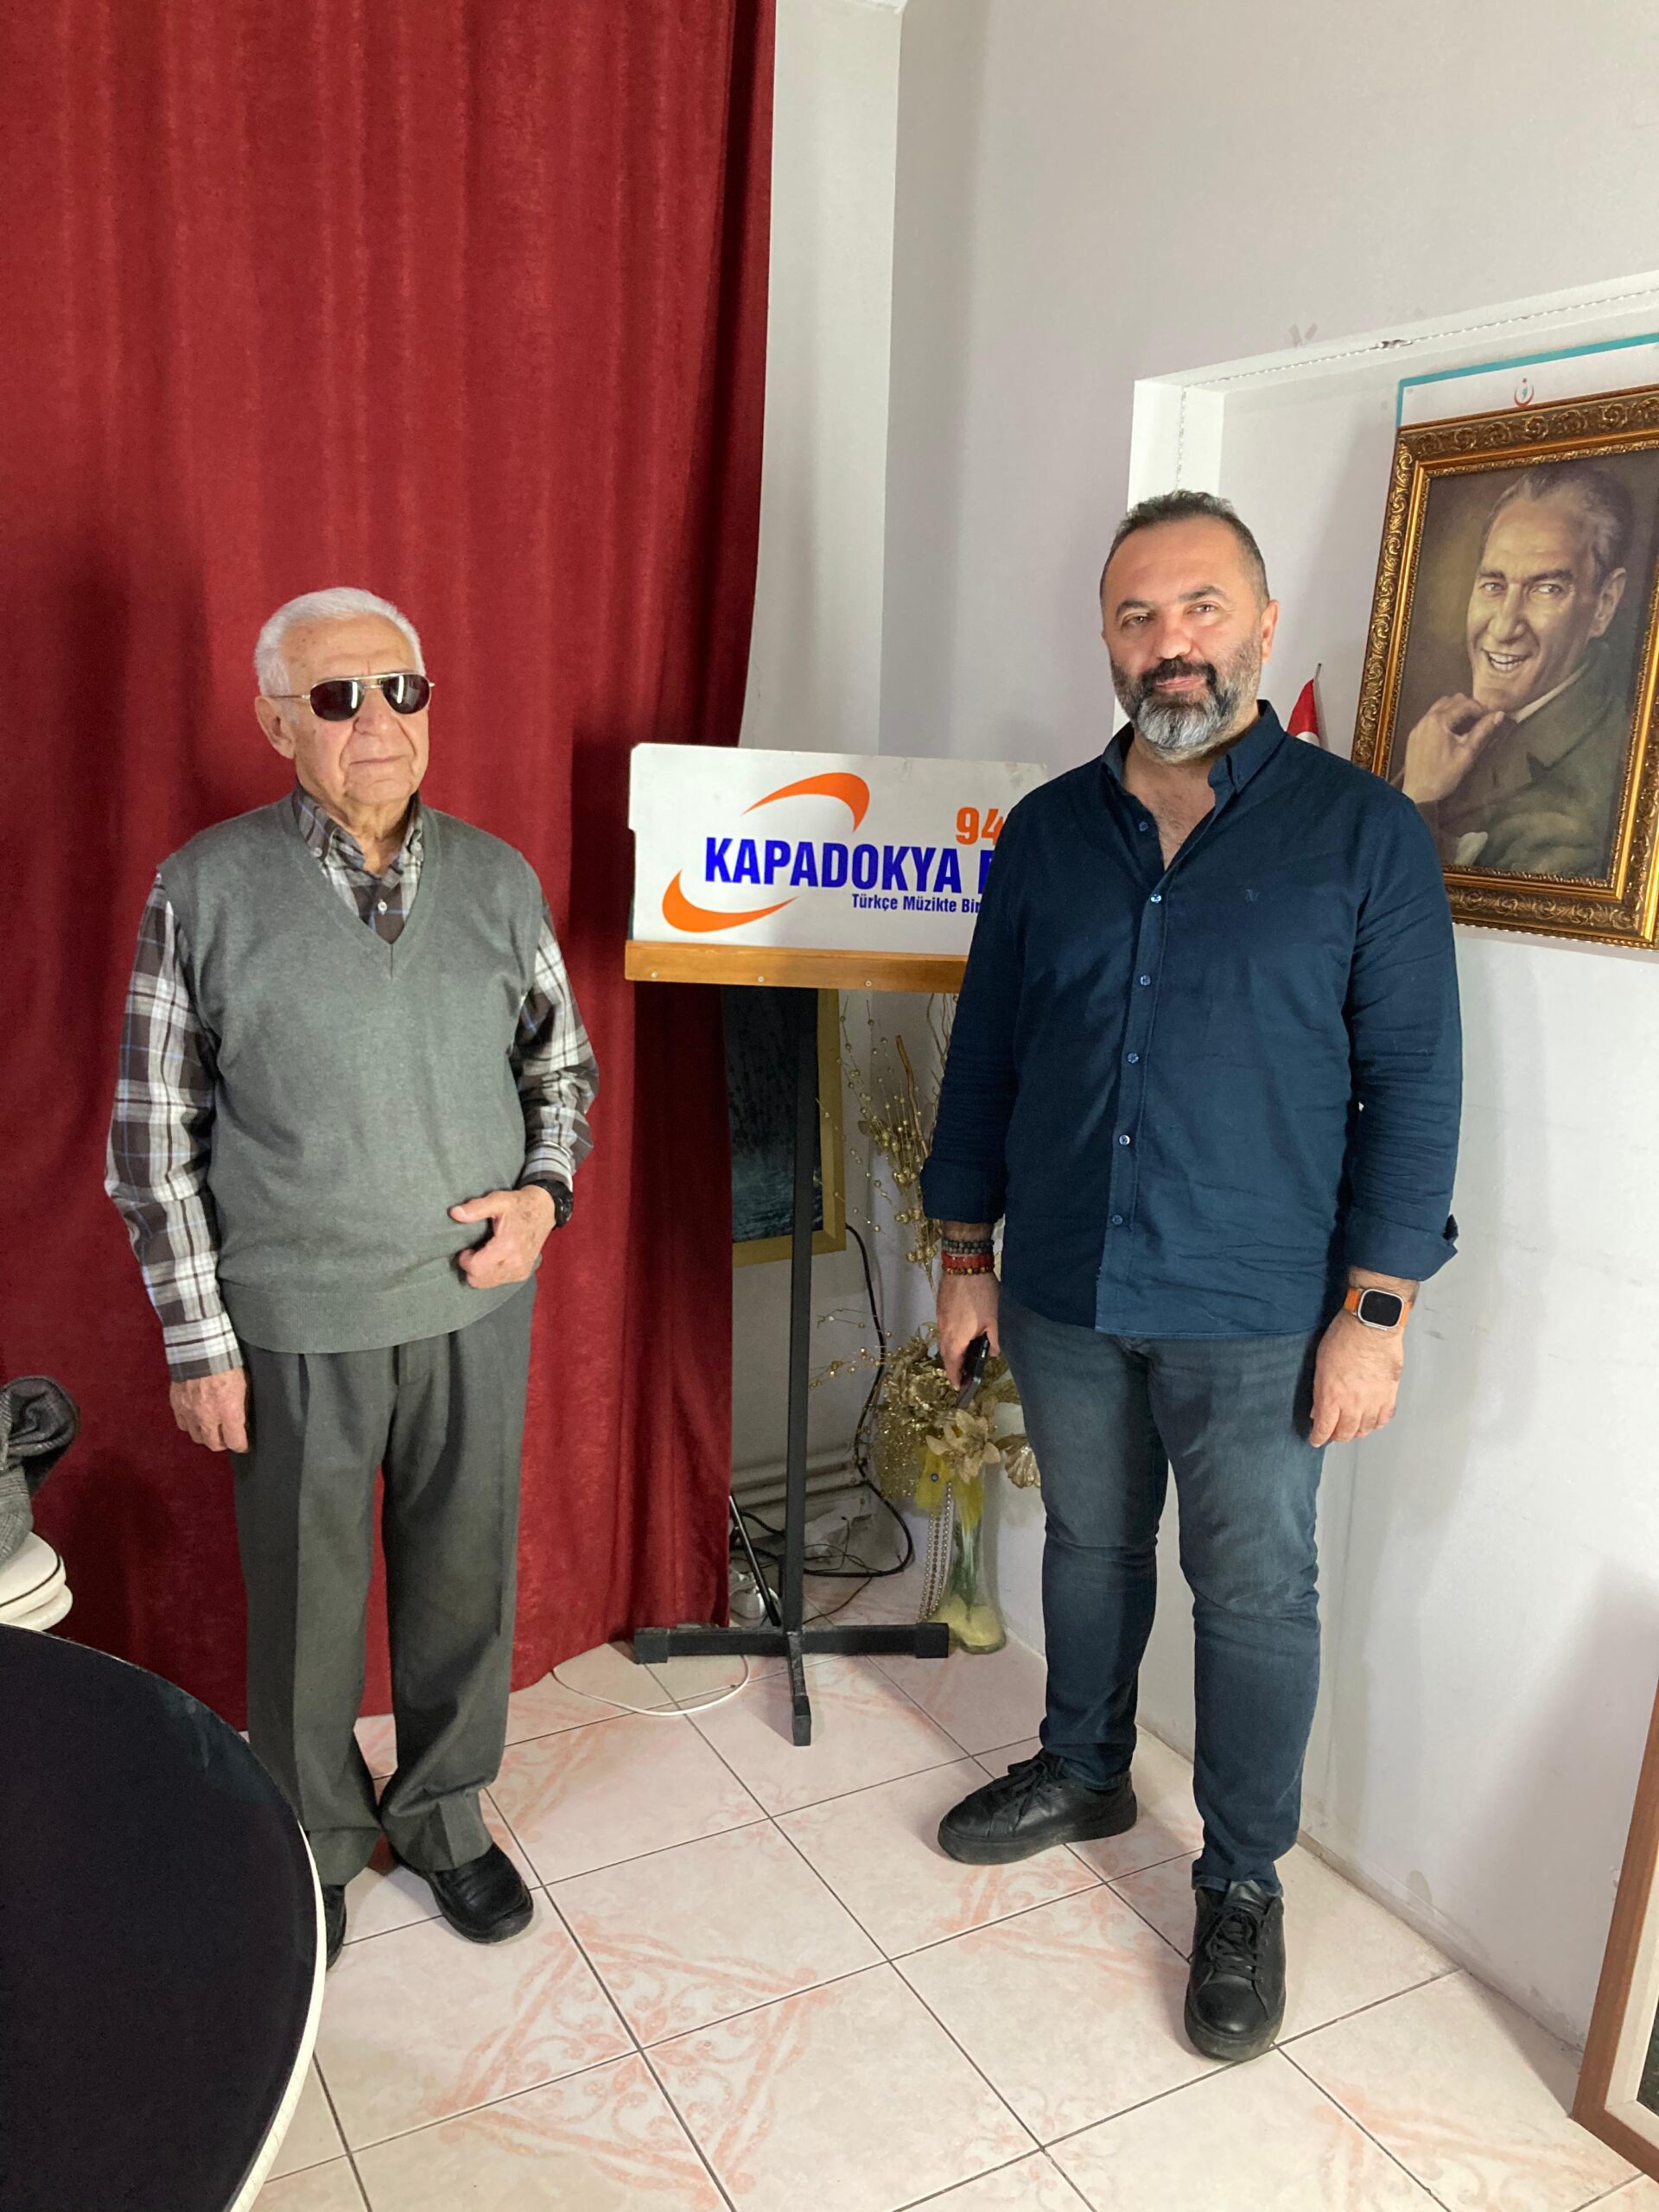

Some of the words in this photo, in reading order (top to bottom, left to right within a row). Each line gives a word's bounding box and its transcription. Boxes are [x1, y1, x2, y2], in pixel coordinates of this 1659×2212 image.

[956, 806, 1004, 846] 94
[705, 836, 962, 893] KAPADOKYA
[852, 893, 898, 912] Türkçe
[903, 895, 957, 912] Müzikte
